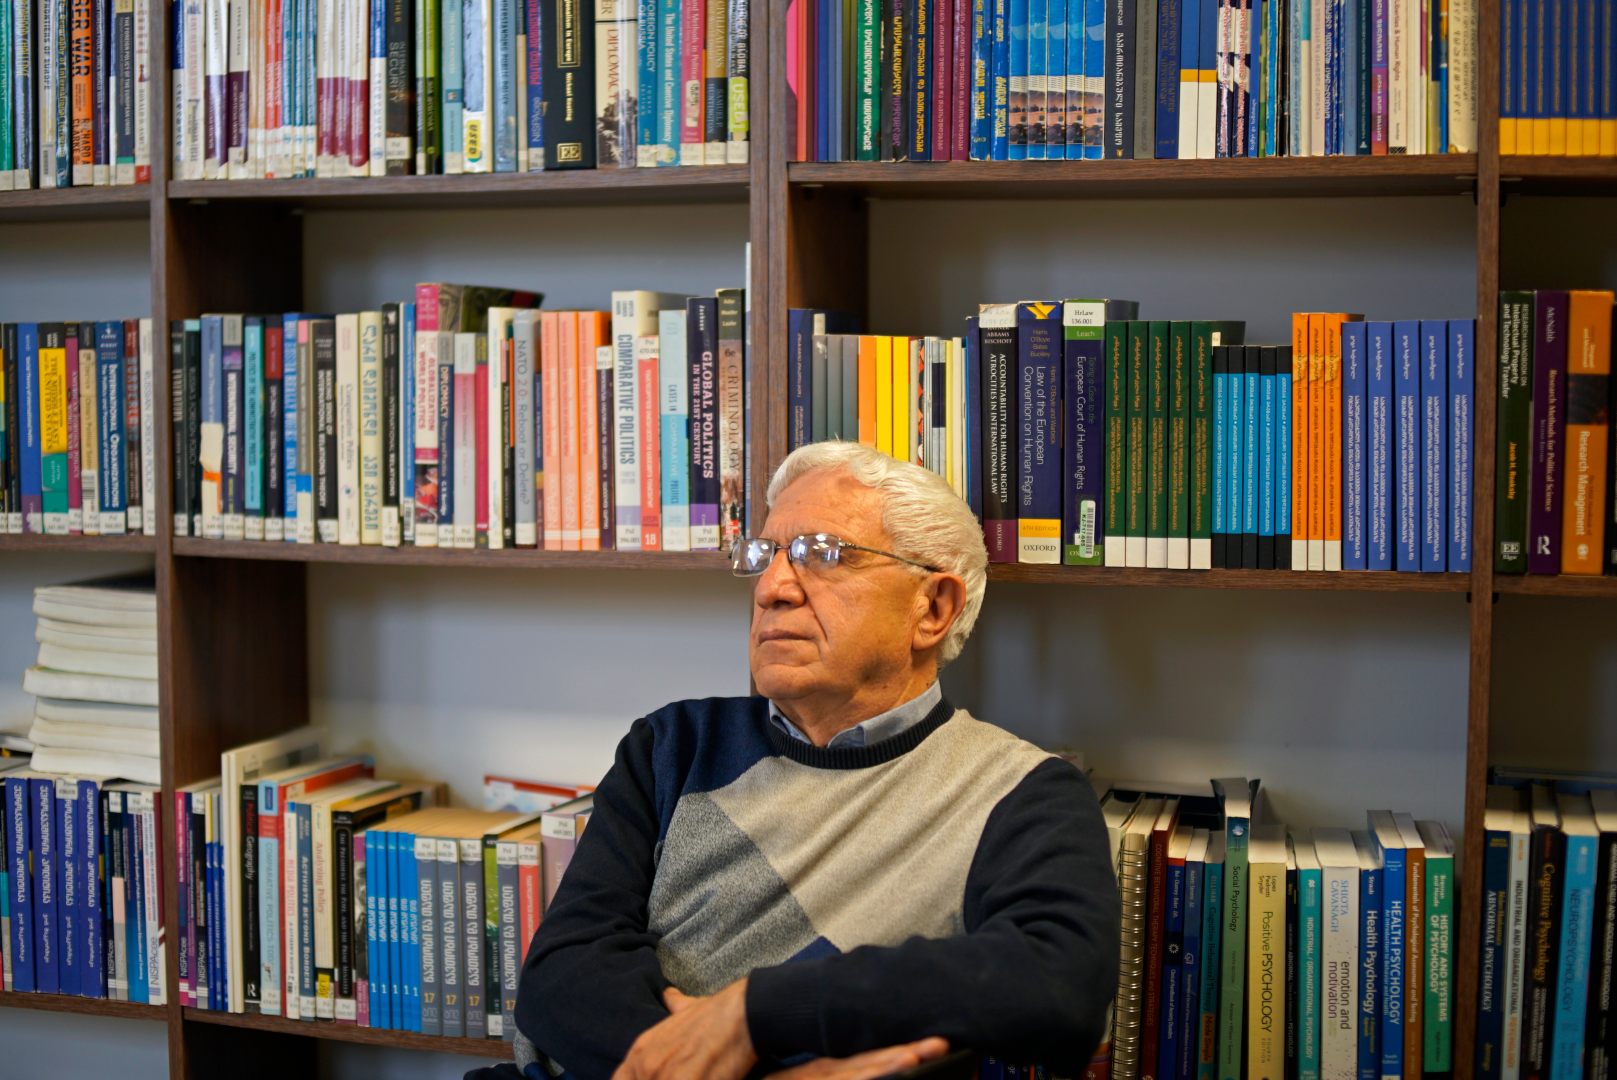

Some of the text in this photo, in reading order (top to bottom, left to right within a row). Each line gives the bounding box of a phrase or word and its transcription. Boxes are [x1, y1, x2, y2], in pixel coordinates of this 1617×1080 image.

[58, 15, 66, 54] Geography
[73, 37, 90, 77] WAR
[564, 39, 573, 62] Europe
[648, 42, 656, 73] POLICY
[691, 14, 700, 44] Methods
[716, 1, 726, 68] CIVILIZATIONS
[737, 43, 748, 73] GLOBAL
[390, 42, 398, 103] SECURITY
[608, 29, 618, 101] DIPLOMACY
[662, 13, 676, 142] The United States and Coercive Diplomacy
[1392, 61, 1401, 81] Rights
[72, 118, 80, 153] CLARKE
[564, 98, 573, 122] Keating
[707, 83, 715, 134] HUNTINGTON
[469, 125, 480, 155] USED
[693, 364, 700, 374] IN
[1086, 357, 1096, 377] Taking
[1501, 320, 1510, 364] Technology
[1509, 350, 1520, 384] Property
[440, 366, 449, 418] DIPLOMACY
[618, 334, 635, 465] COMPARATIVE POLITICS
[669, 384, 677, 403] CASES
[702, 351, 713, 479] GLOBAL POLITICS
[991, 401, 997, 410] IN
[1035, 366, 1046, 465] Law of the European
[1088, 404, 1096, 412] to
[1548, 370, 1557, 404] Research
[109, 364, 120, 508] INTERNATIONAL ORGANIZATIONS
[144, 371, 154, 495] RUSSIAN FOREIGN POLICY
[228, 373, 237, 475] INTERNATIONAL SECURITY
[518, 340, 530, 505] NATO Reboot Delete?
[670, 416, 678, 477] COMPARATIVE
[728, 364, 740, 475] CRIMINOLOGY
[1022, 366, 1034, 506] Convention on Human Rights
[1075, 356, 1086, 490] European Court of Human Rights
[1548, 406, 1556, 438] Methods
[671, 480, 679, 505] POLITICS
[1508, 471, 1516, 499] Rooksby
[1546, 452, 1555, 482] Political
[1574, 430, 1590, 535] Research Management
[1546, 484, 1554, 512] Science
[644, 533, 656, 545] 18
[1229, 866, 1240, 932] Social Psychology
[1534, 863, 1555, 982] Cognitive Psychology
[1262, 911, 1273, 1033] Positive PSYCHOLOGY
[1362, 910, 1378, 1014] Health Psychology
[1390, 901, 1402, 1025] HEALTH PSYCHOLOGY
[1430, 915, 1439, 993] OF PSYCHOLOGY
[1439, 915, 1448, 1022] HISTORY AND SYSTEMS
[1482, 890, 1496, 1012] ABNORMAL PSYCHOLOGY
[1510, 880, 1524, 1015] INDUSTRIAL AND ORGANIZATIONAL
[1564, 888, 1580, 1013] NEUROPSYCHOLOGY
[1328, 961, 1339, 1019] motivation
[1340, 961, 1352, 1030] emotion and
[1508, 1016, 1518, 1069] PSYCHOLOGY
